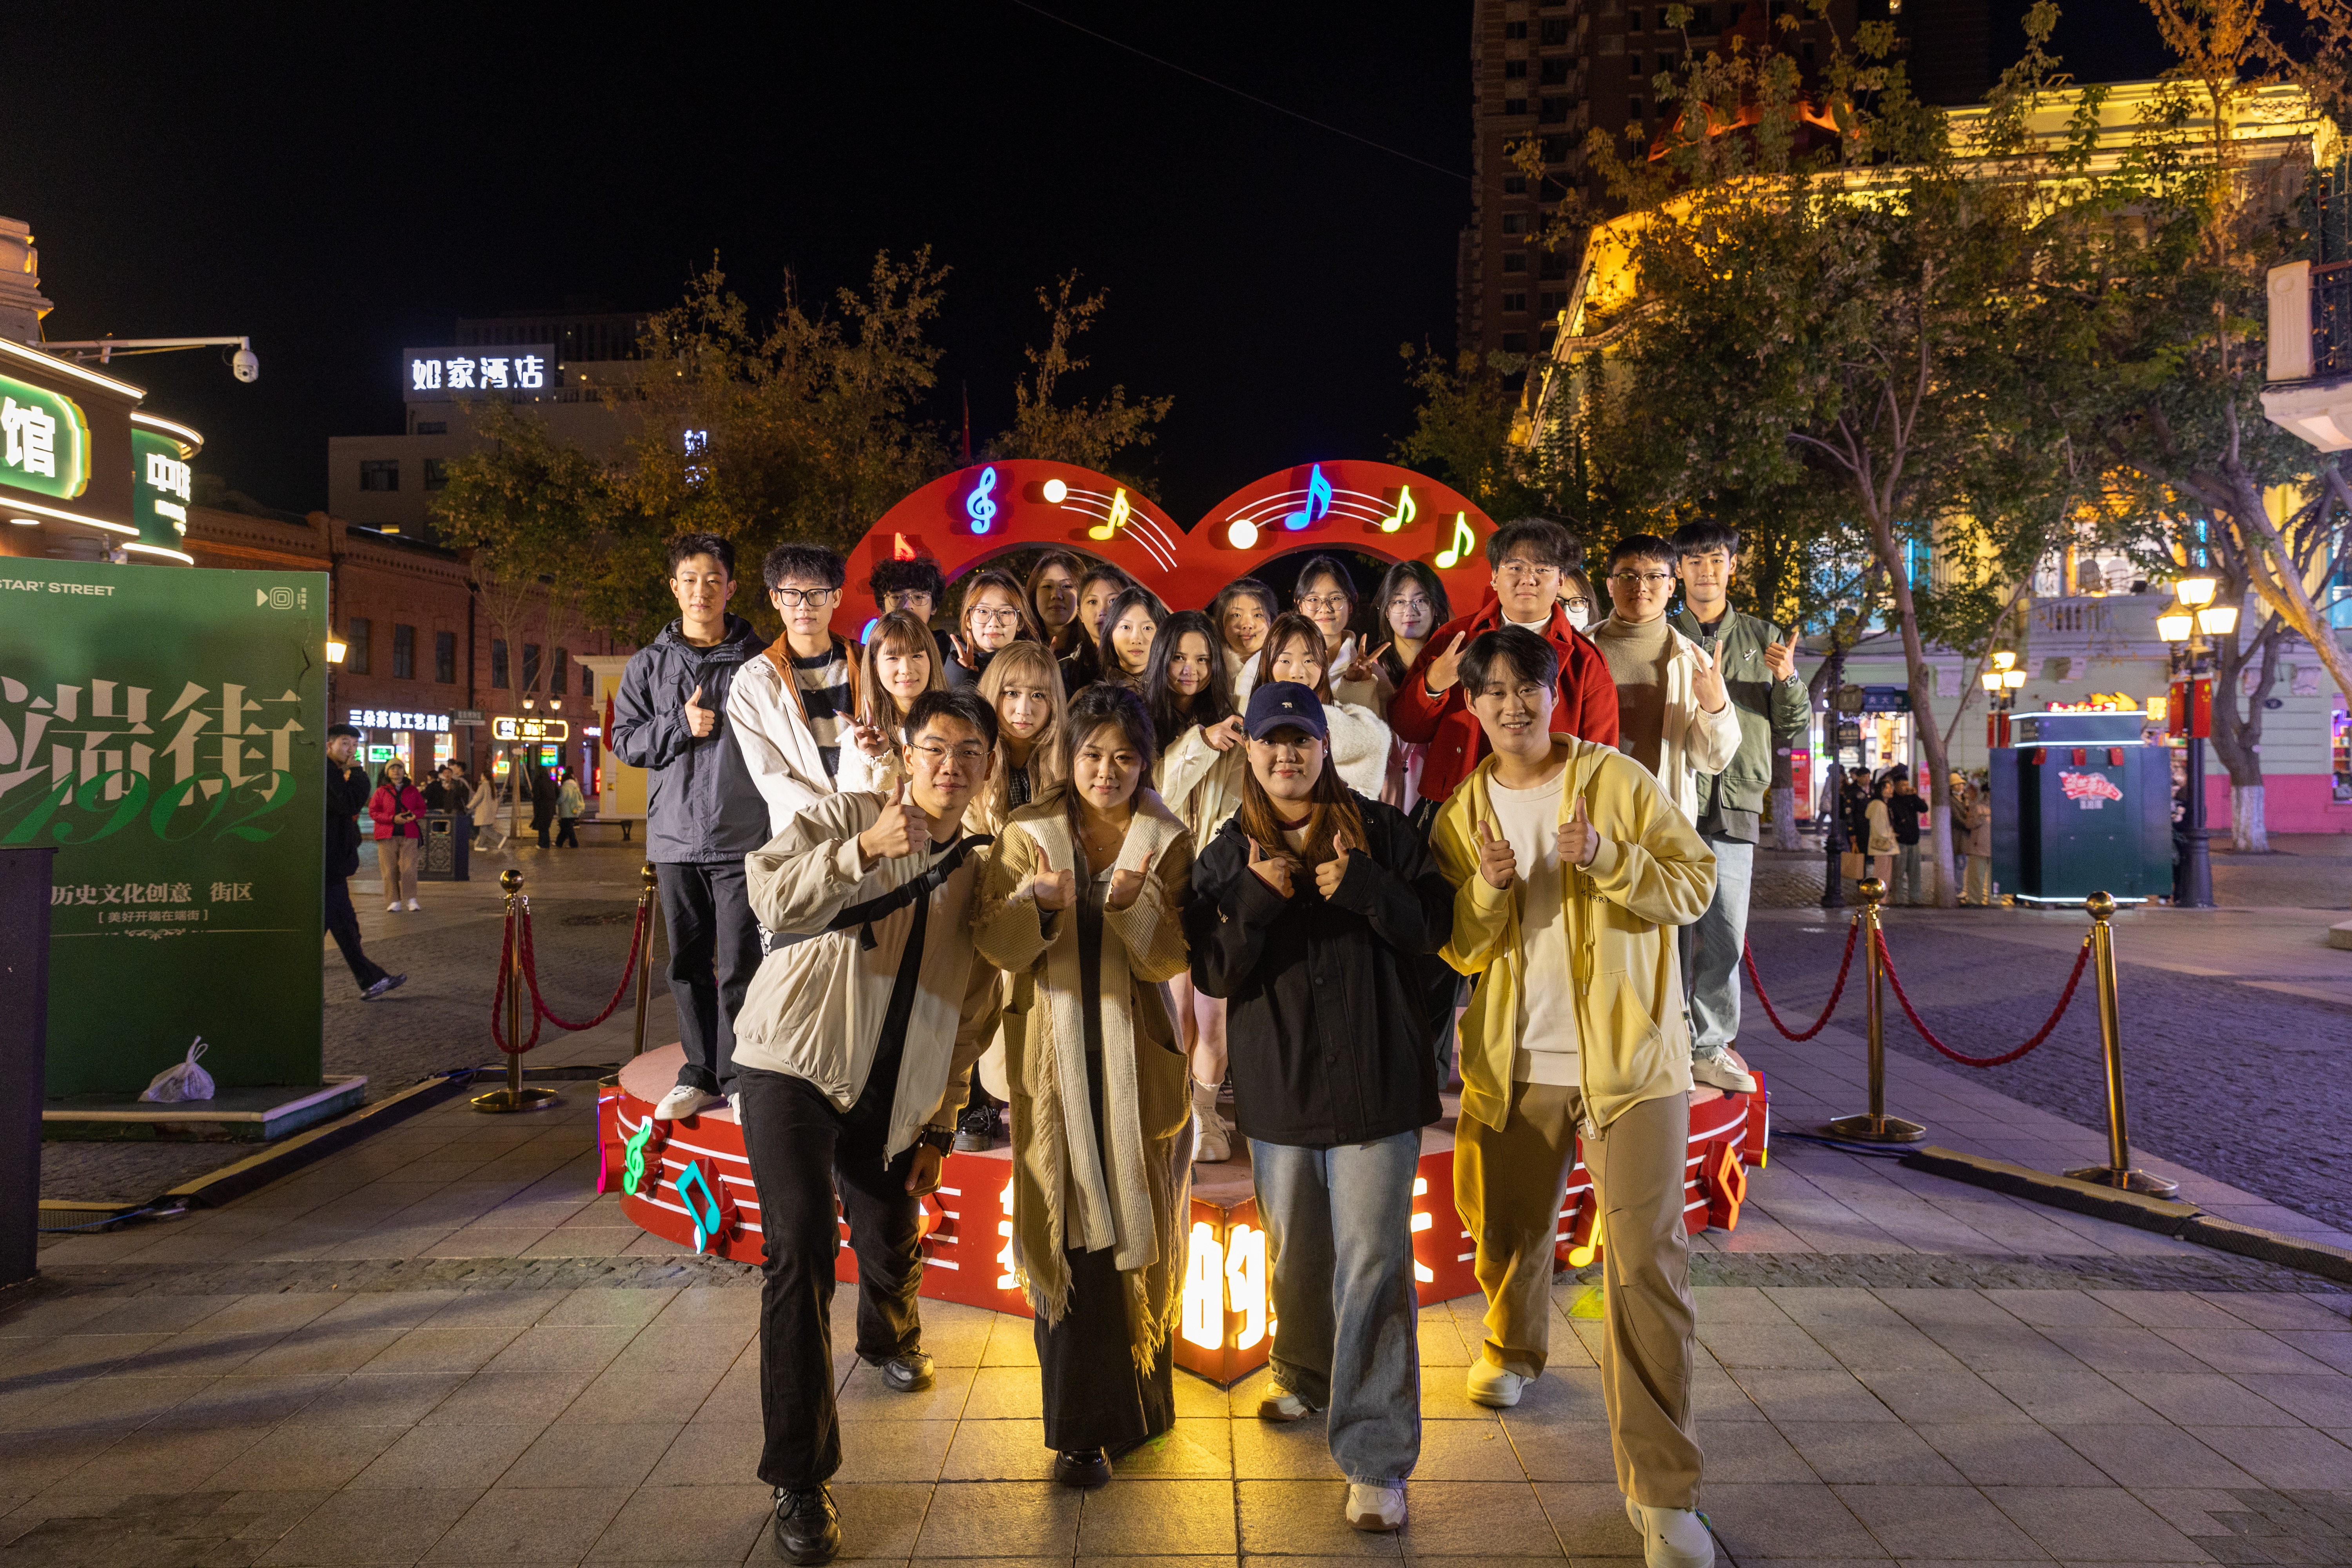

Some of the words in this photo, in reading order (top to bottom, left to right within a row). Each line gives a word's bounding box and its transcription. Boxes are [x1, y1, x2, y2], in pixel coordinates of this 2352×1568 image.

[412, 355, 544, 390] 如家酒店
[0, 396, 55, 478] 馆
[48, 582, 115, 596] STREET
[51, 882, 192, 906] 历史文化创意
[210, 882, 254, 902] 街区
